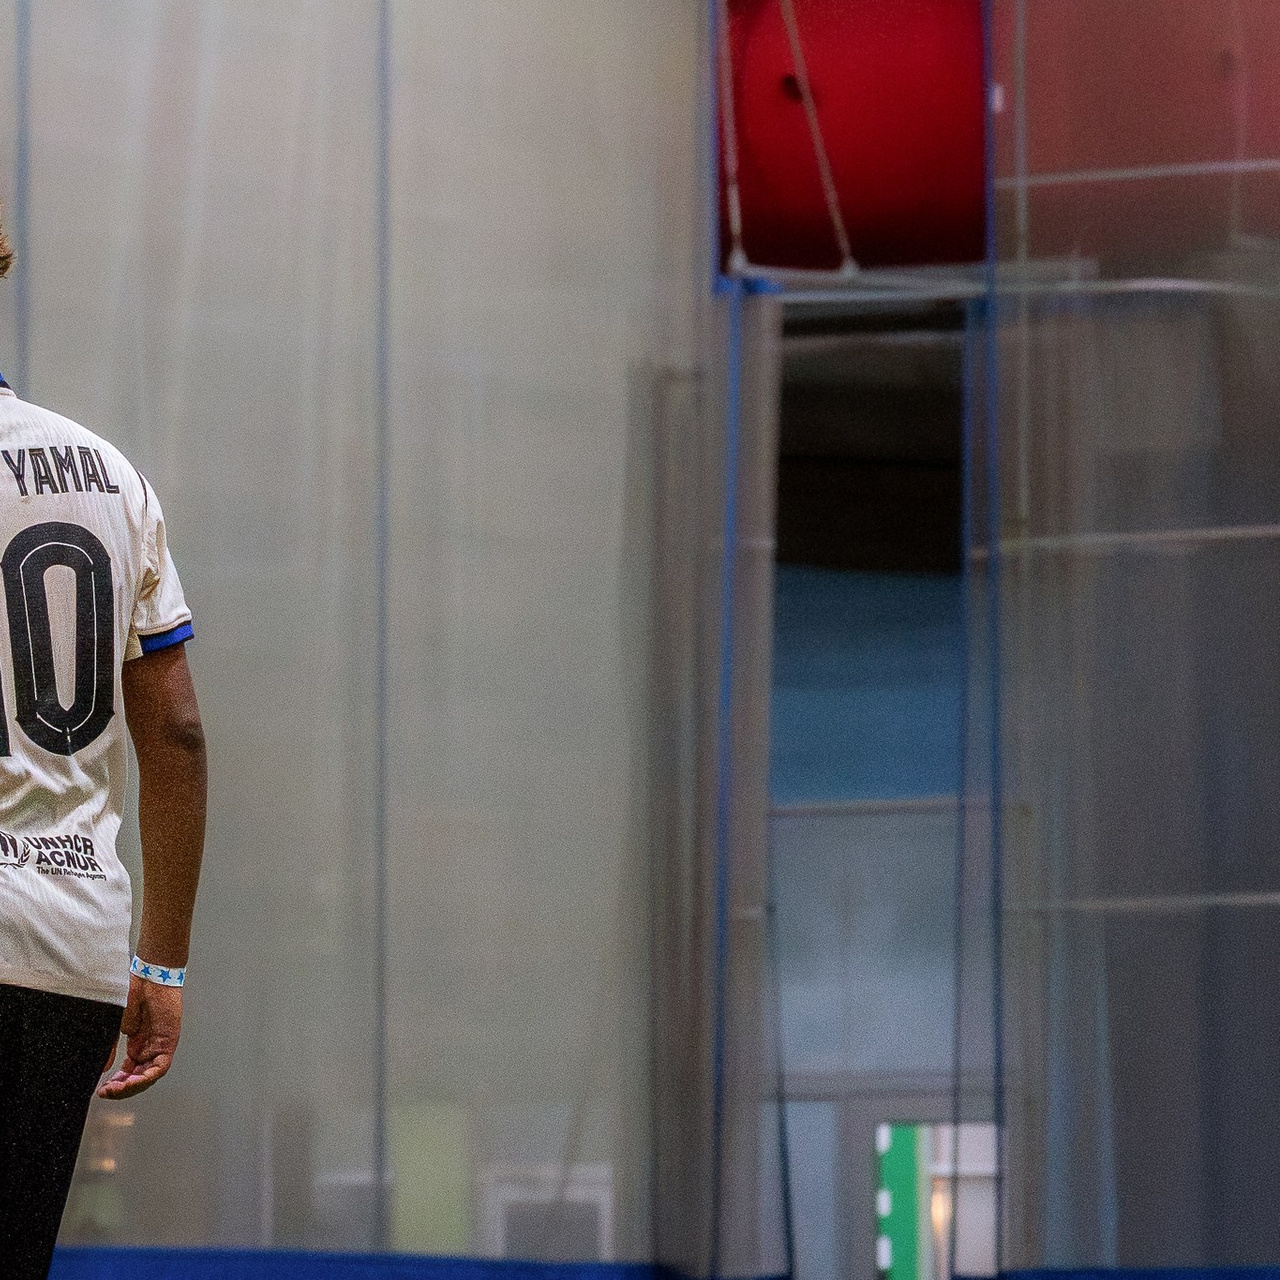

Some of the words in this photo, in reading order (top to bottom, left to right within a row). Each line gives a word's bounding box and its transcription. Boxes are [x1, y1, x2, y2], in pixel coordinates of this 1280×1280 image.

[1, 446, 120, 496] YAMAL
[24, 834, 95, 856] UNHCR
[36, 851, 103, 872] ACNUR
[37, 866, 50, 874] The
[51, 867, 62, 875] UN
